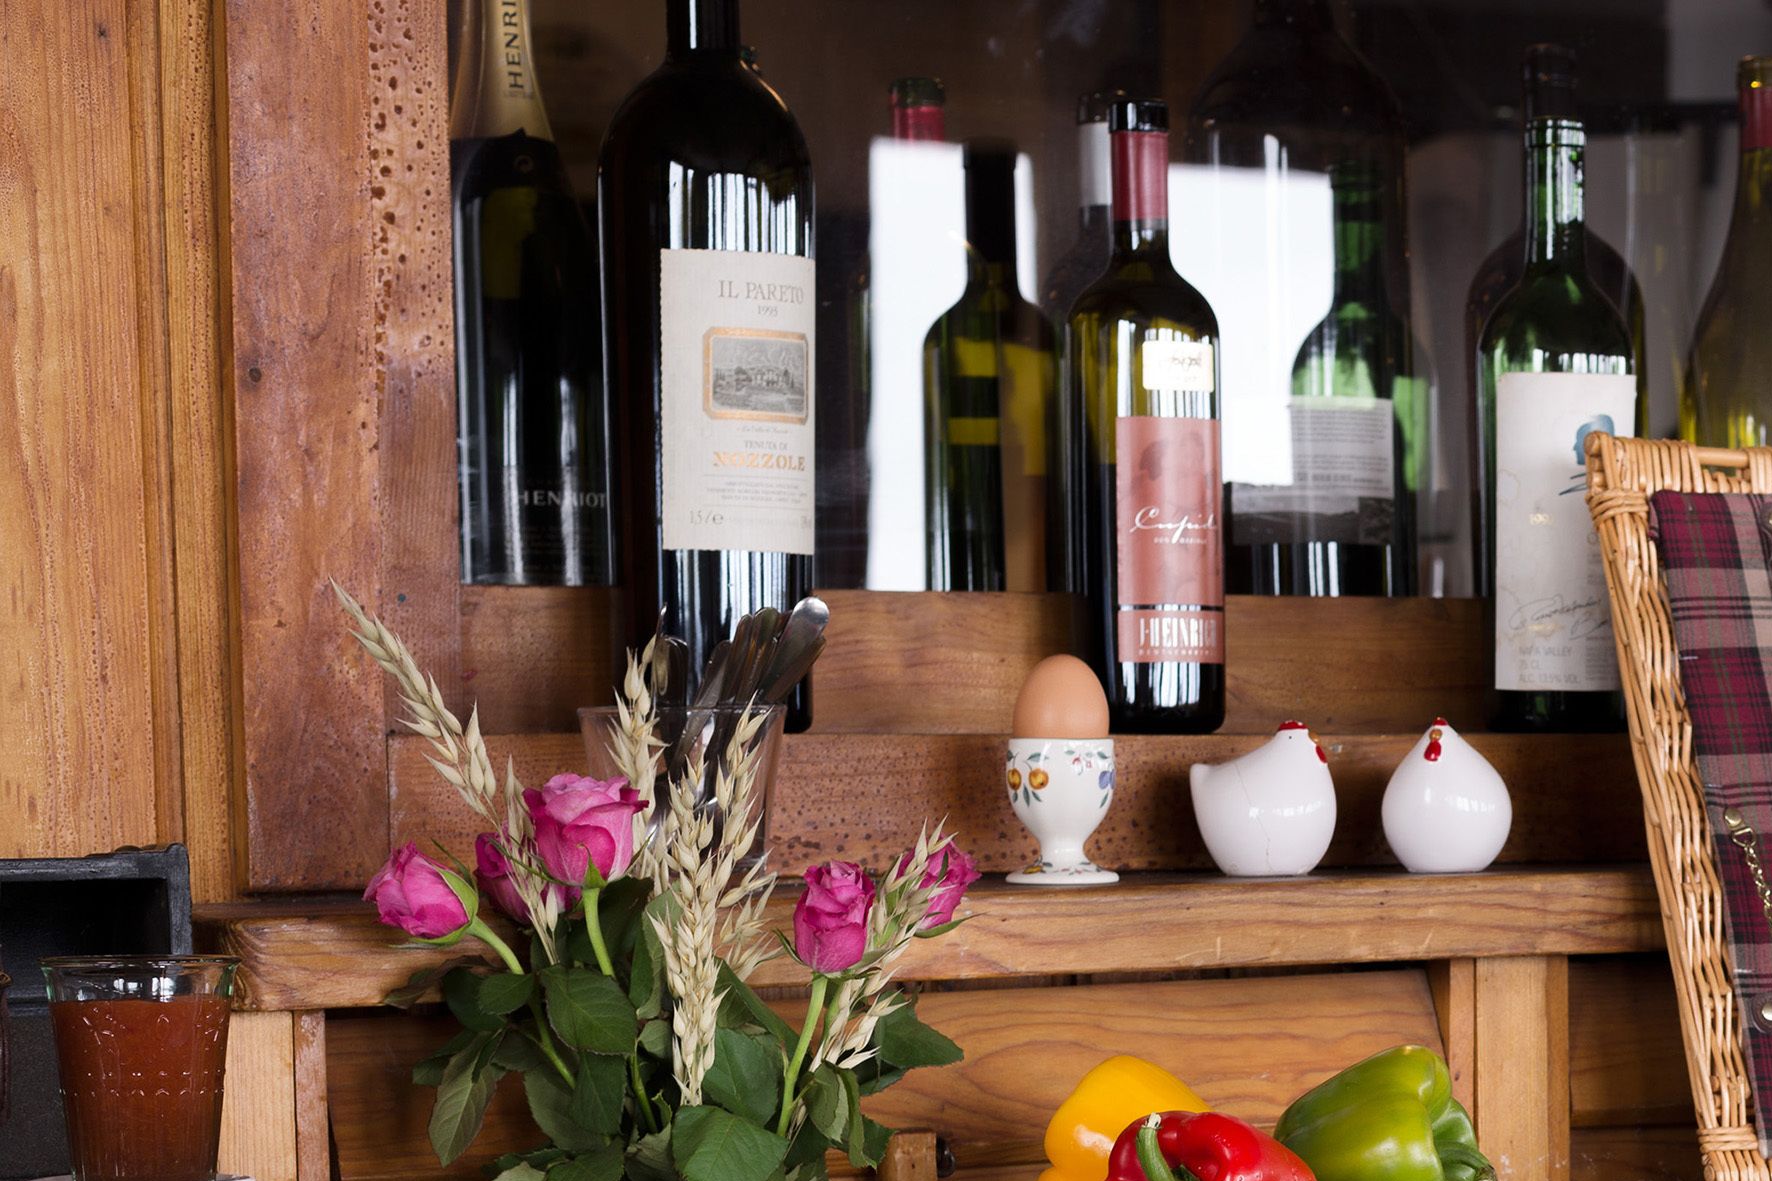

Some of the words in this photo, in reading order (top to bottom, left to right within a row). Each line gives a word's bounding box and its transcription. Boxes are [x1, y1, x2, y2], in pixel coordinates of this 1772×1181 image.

[718, 279, 739, 299] IL
[745, 281, 804, 304] PARETO
[713, 451, 805, 471] NOZZOLE
[513, 489, 608, 508] HENIOT
